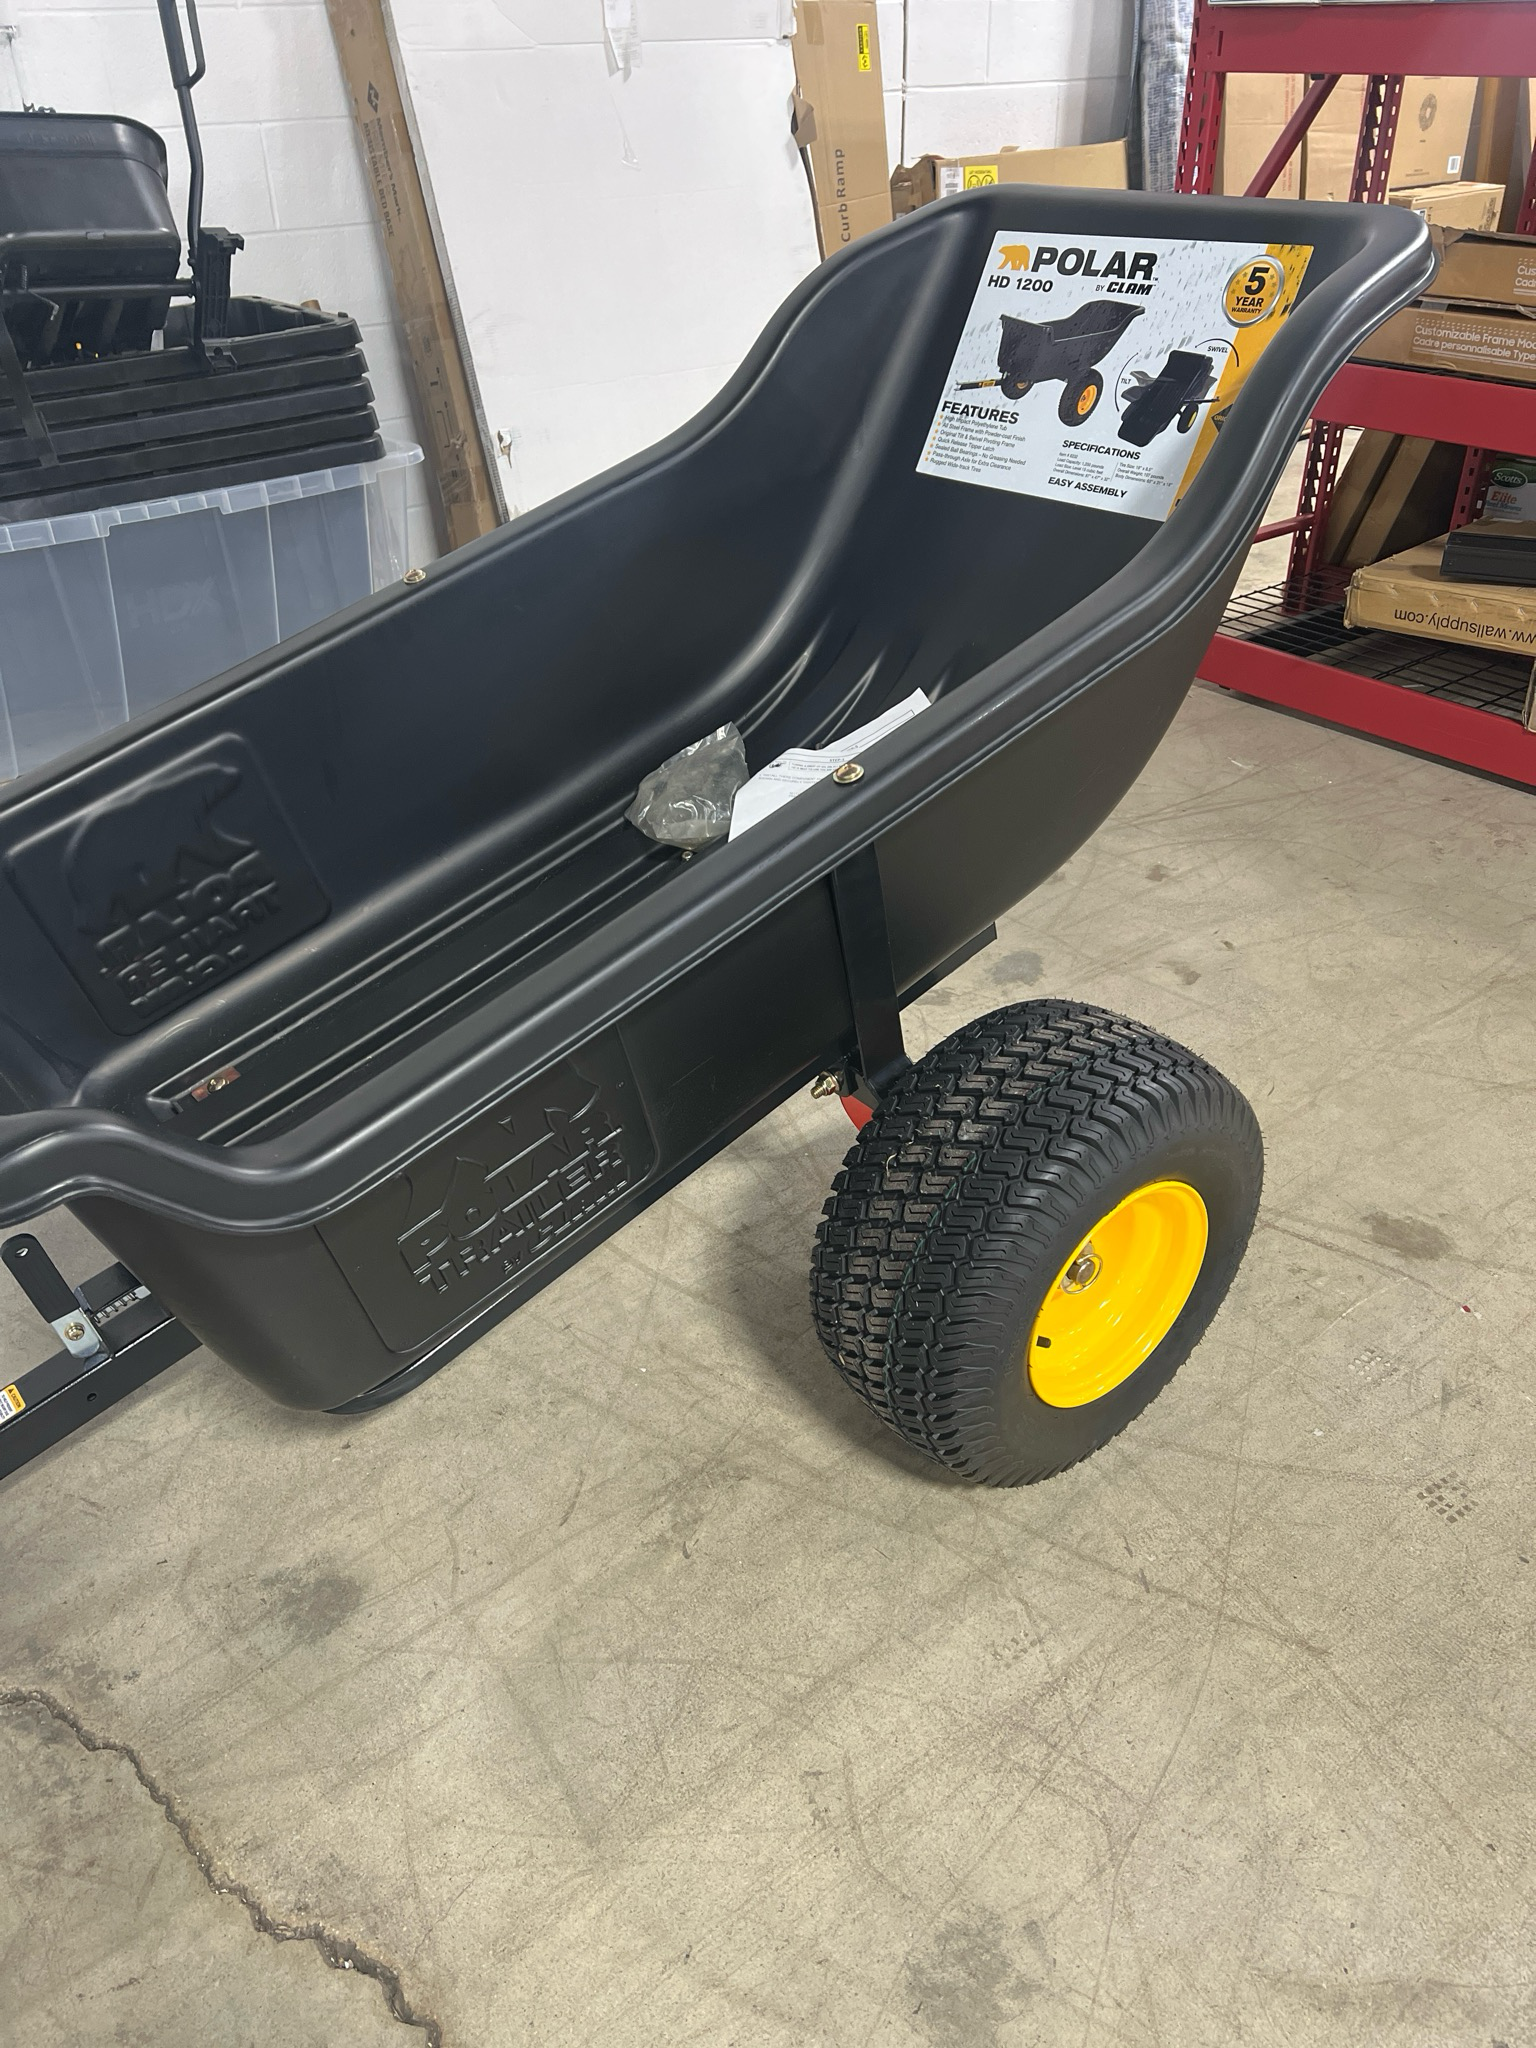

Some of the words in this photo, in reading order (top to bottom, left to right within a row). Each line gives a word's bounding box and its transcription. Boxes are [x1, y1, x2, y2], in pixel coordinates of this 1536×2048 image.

[835, 148, 847, 199] Ramp
[378, 188, 387, 210] BED
[384, 211, 395, 238] BASE
[838, 203, 851, 243] Curb
[1030, 246, 1158, 281] POLAR
[987, 275, 1010, 288] HD
[1016, 278, 1054, 293] 1200
[1095, 284, 1105, 292] BY
[1106, 281, 1153, 295] CLAM
[1244, 266, 1270, 295] 5
[1231, 306, 1262, 314] WARRANTY
[1235, 296, 1264, 307] YEAR
[1415, 325, 1480, 342] Customizable
[1482, 334, 1515, 347] Frame
[1207, 345, 1228, 354] SWIVEL
[1413, 336, 1440, 348] Cadre
[1441, 341, 1511, 358] personnalisable
[1513, 350, 1536, 362] Type
[941, 400, 1020, 425] FEATURES
[956, 416, 970, 425] Impact
[971, 420, 998, 430] Polyethylene
[940, 430, 956, 438] Original
[983, 438, 1000, 446] Pivoting
[984, 430, 1012, 440] Powder-coat
[968, 442, 982, 450] Tipper
[1062, 440, 1141, 460] SPECIFICATIONS
[930, 458, 947, 466] Rugged
[947, 462, 970, 470] Wide-track
[932, 450, 961, 460] Pass-through
[990, 462, 1012, 471] Clearance
[960, 448, 978, 457] Bearings
[989, 454, 1008, 463] Greasing
[1008, 457, 1026, 466] Needed
[1048, 476, 1074, 488] EASY
[1074, 482, 1128, 498] ASSEMBLY
[1494, 471, 1522, 484] Scotts
[1490, 490, 1517, 505] Elite
[397, 1108, 624, 1275] POLAR
[418, 1148, 625, 1294] TRAILER
